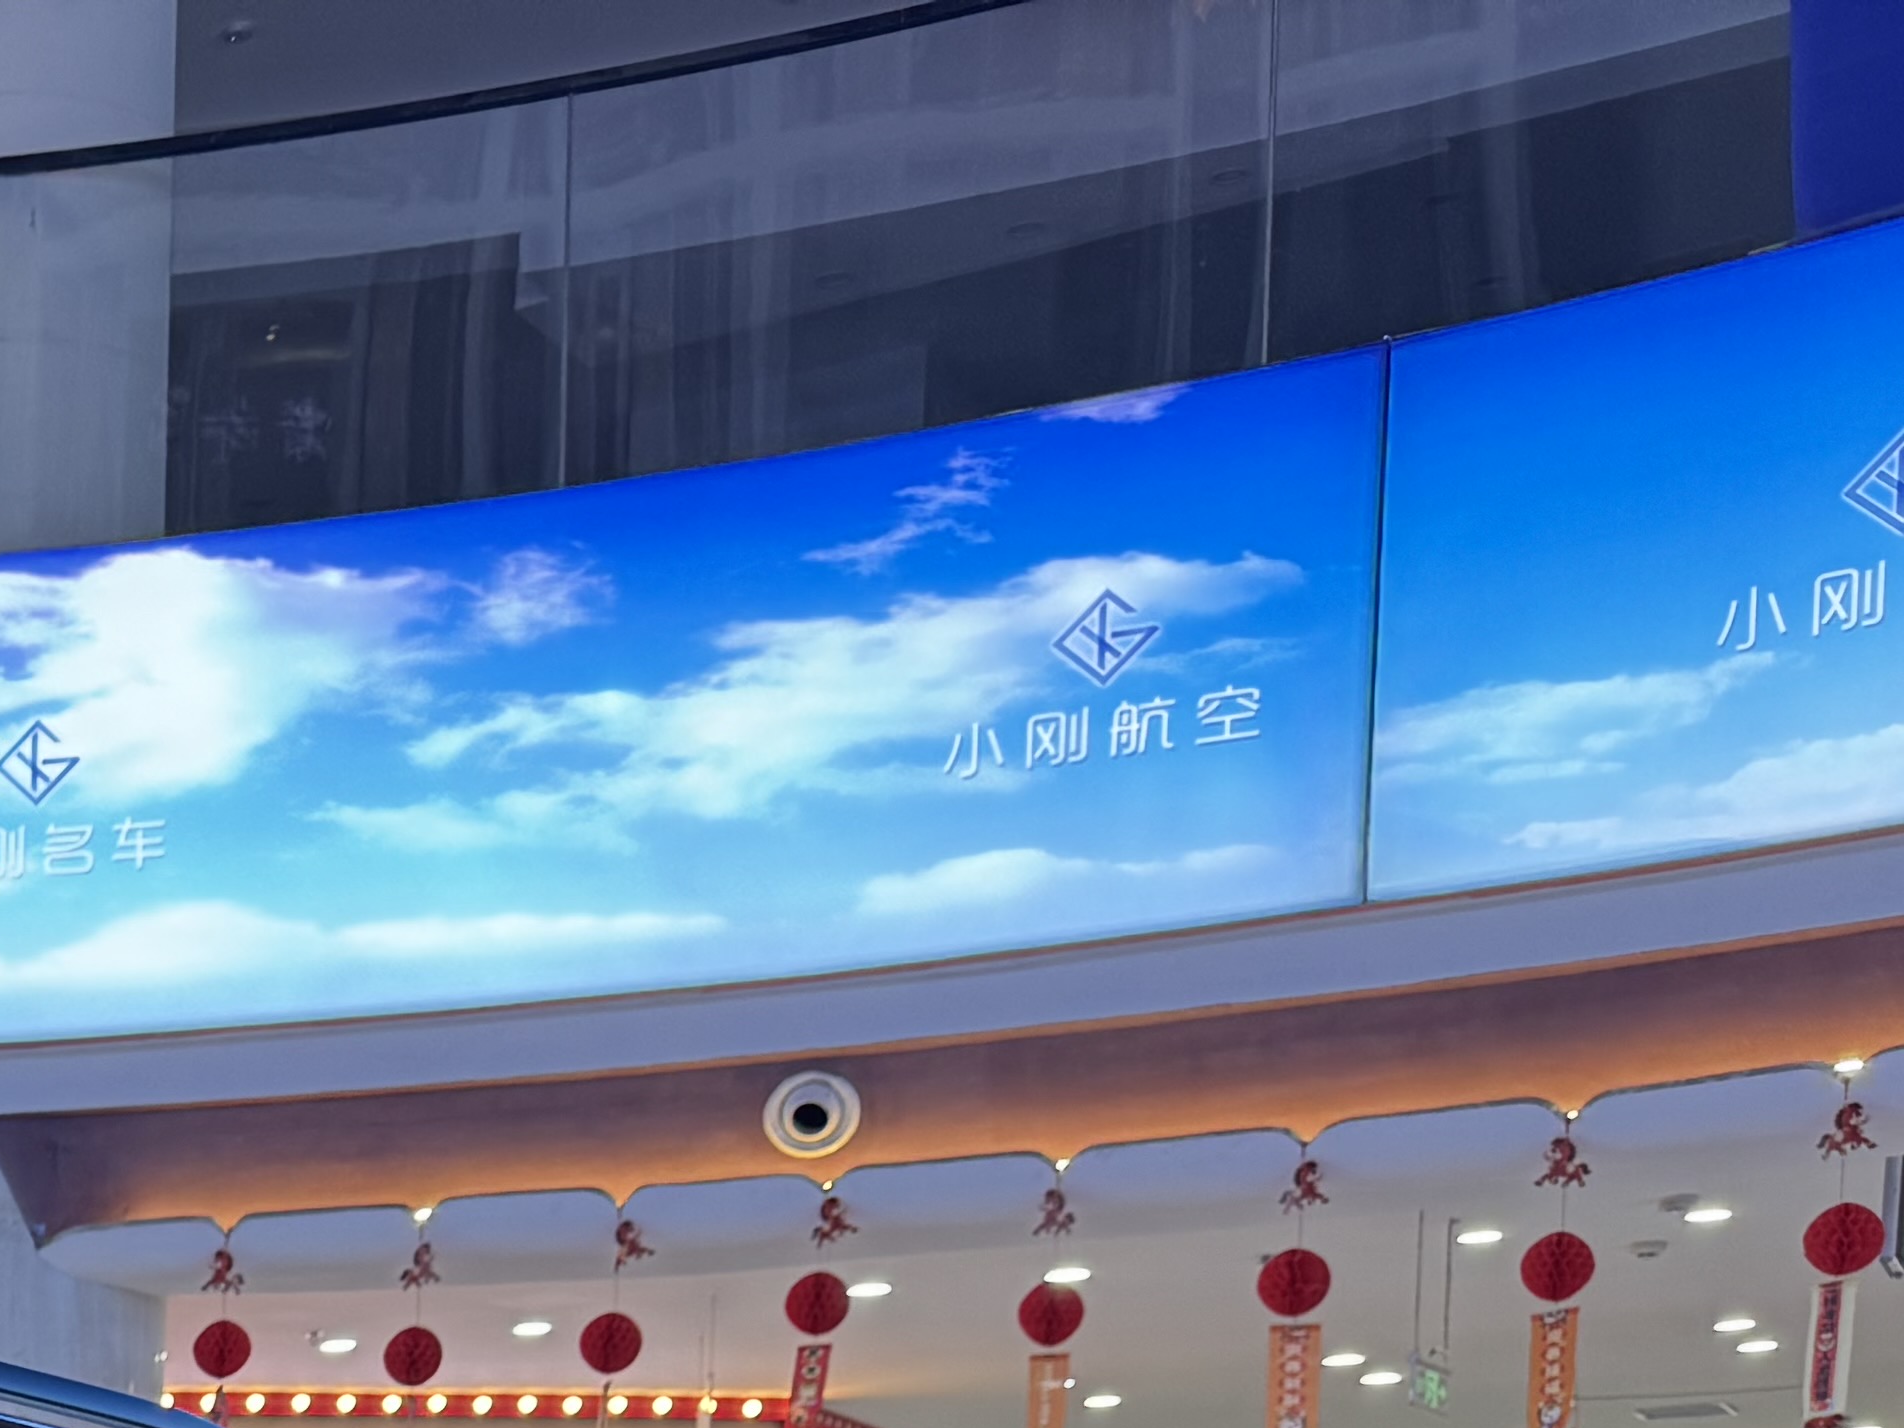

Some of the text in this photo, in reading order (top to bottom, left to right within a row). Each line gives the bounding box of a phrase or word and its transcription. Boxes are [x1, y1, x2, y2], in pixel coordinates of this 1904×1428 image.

[1716, 559, 1886, 650] 小刚
[943, 684, 1261, 779] 小刚航空
